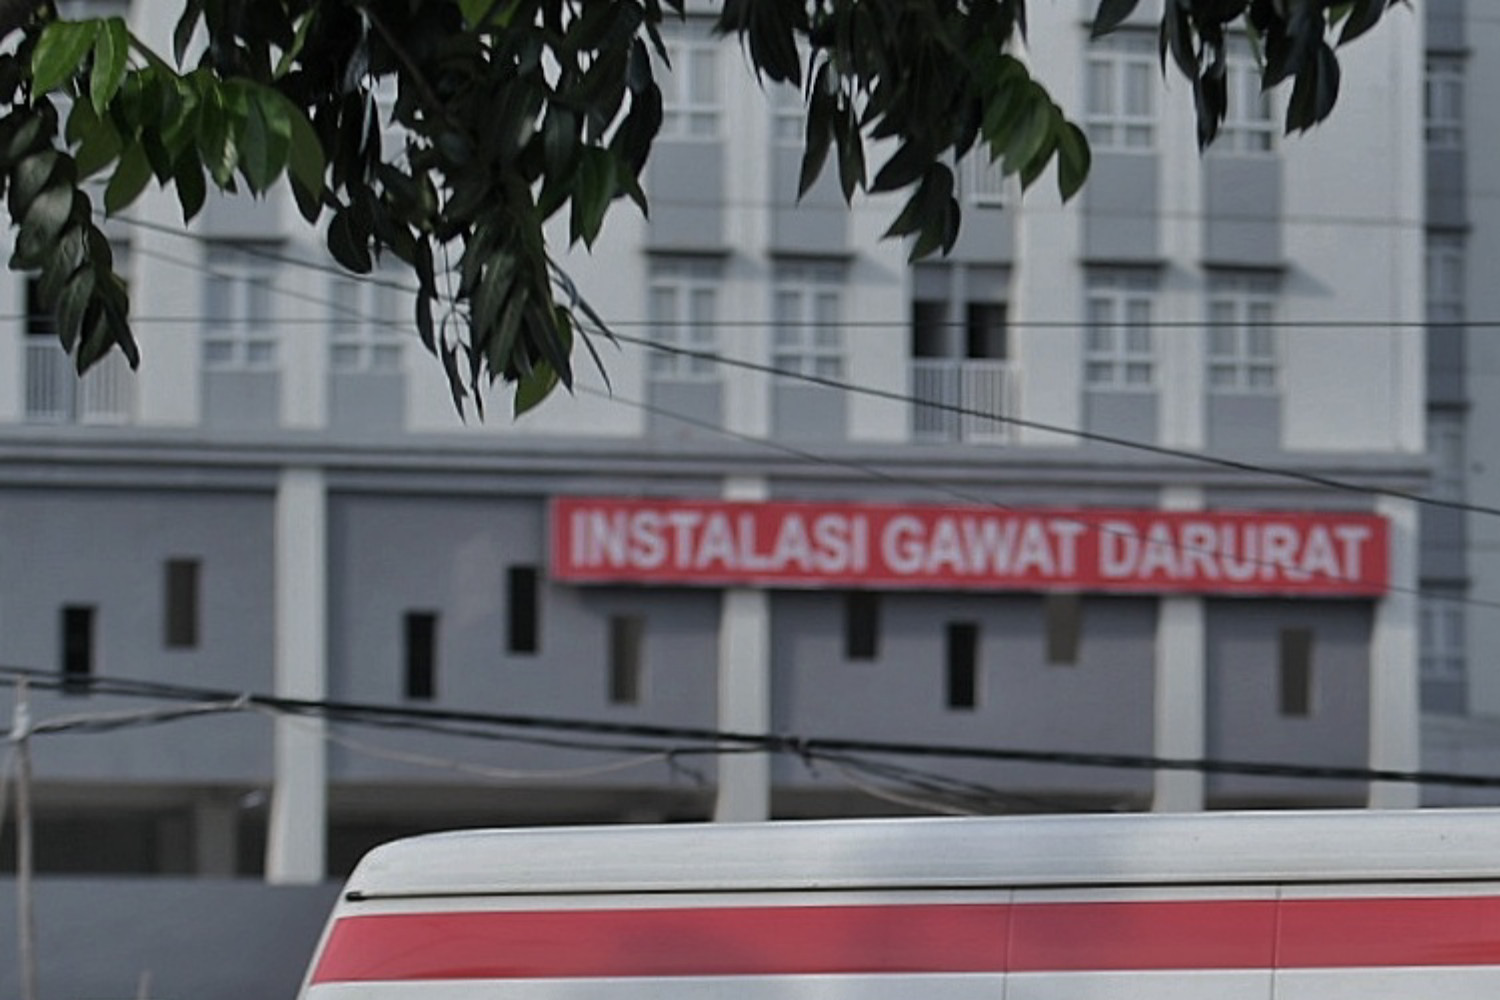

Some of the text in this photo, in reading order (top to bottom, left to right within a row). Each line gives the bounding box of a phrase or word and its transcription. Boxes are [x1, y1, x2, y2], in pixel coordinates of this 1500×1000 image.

[570, 509, 1372, 581] INSTALASI GAWAT DARURAT
